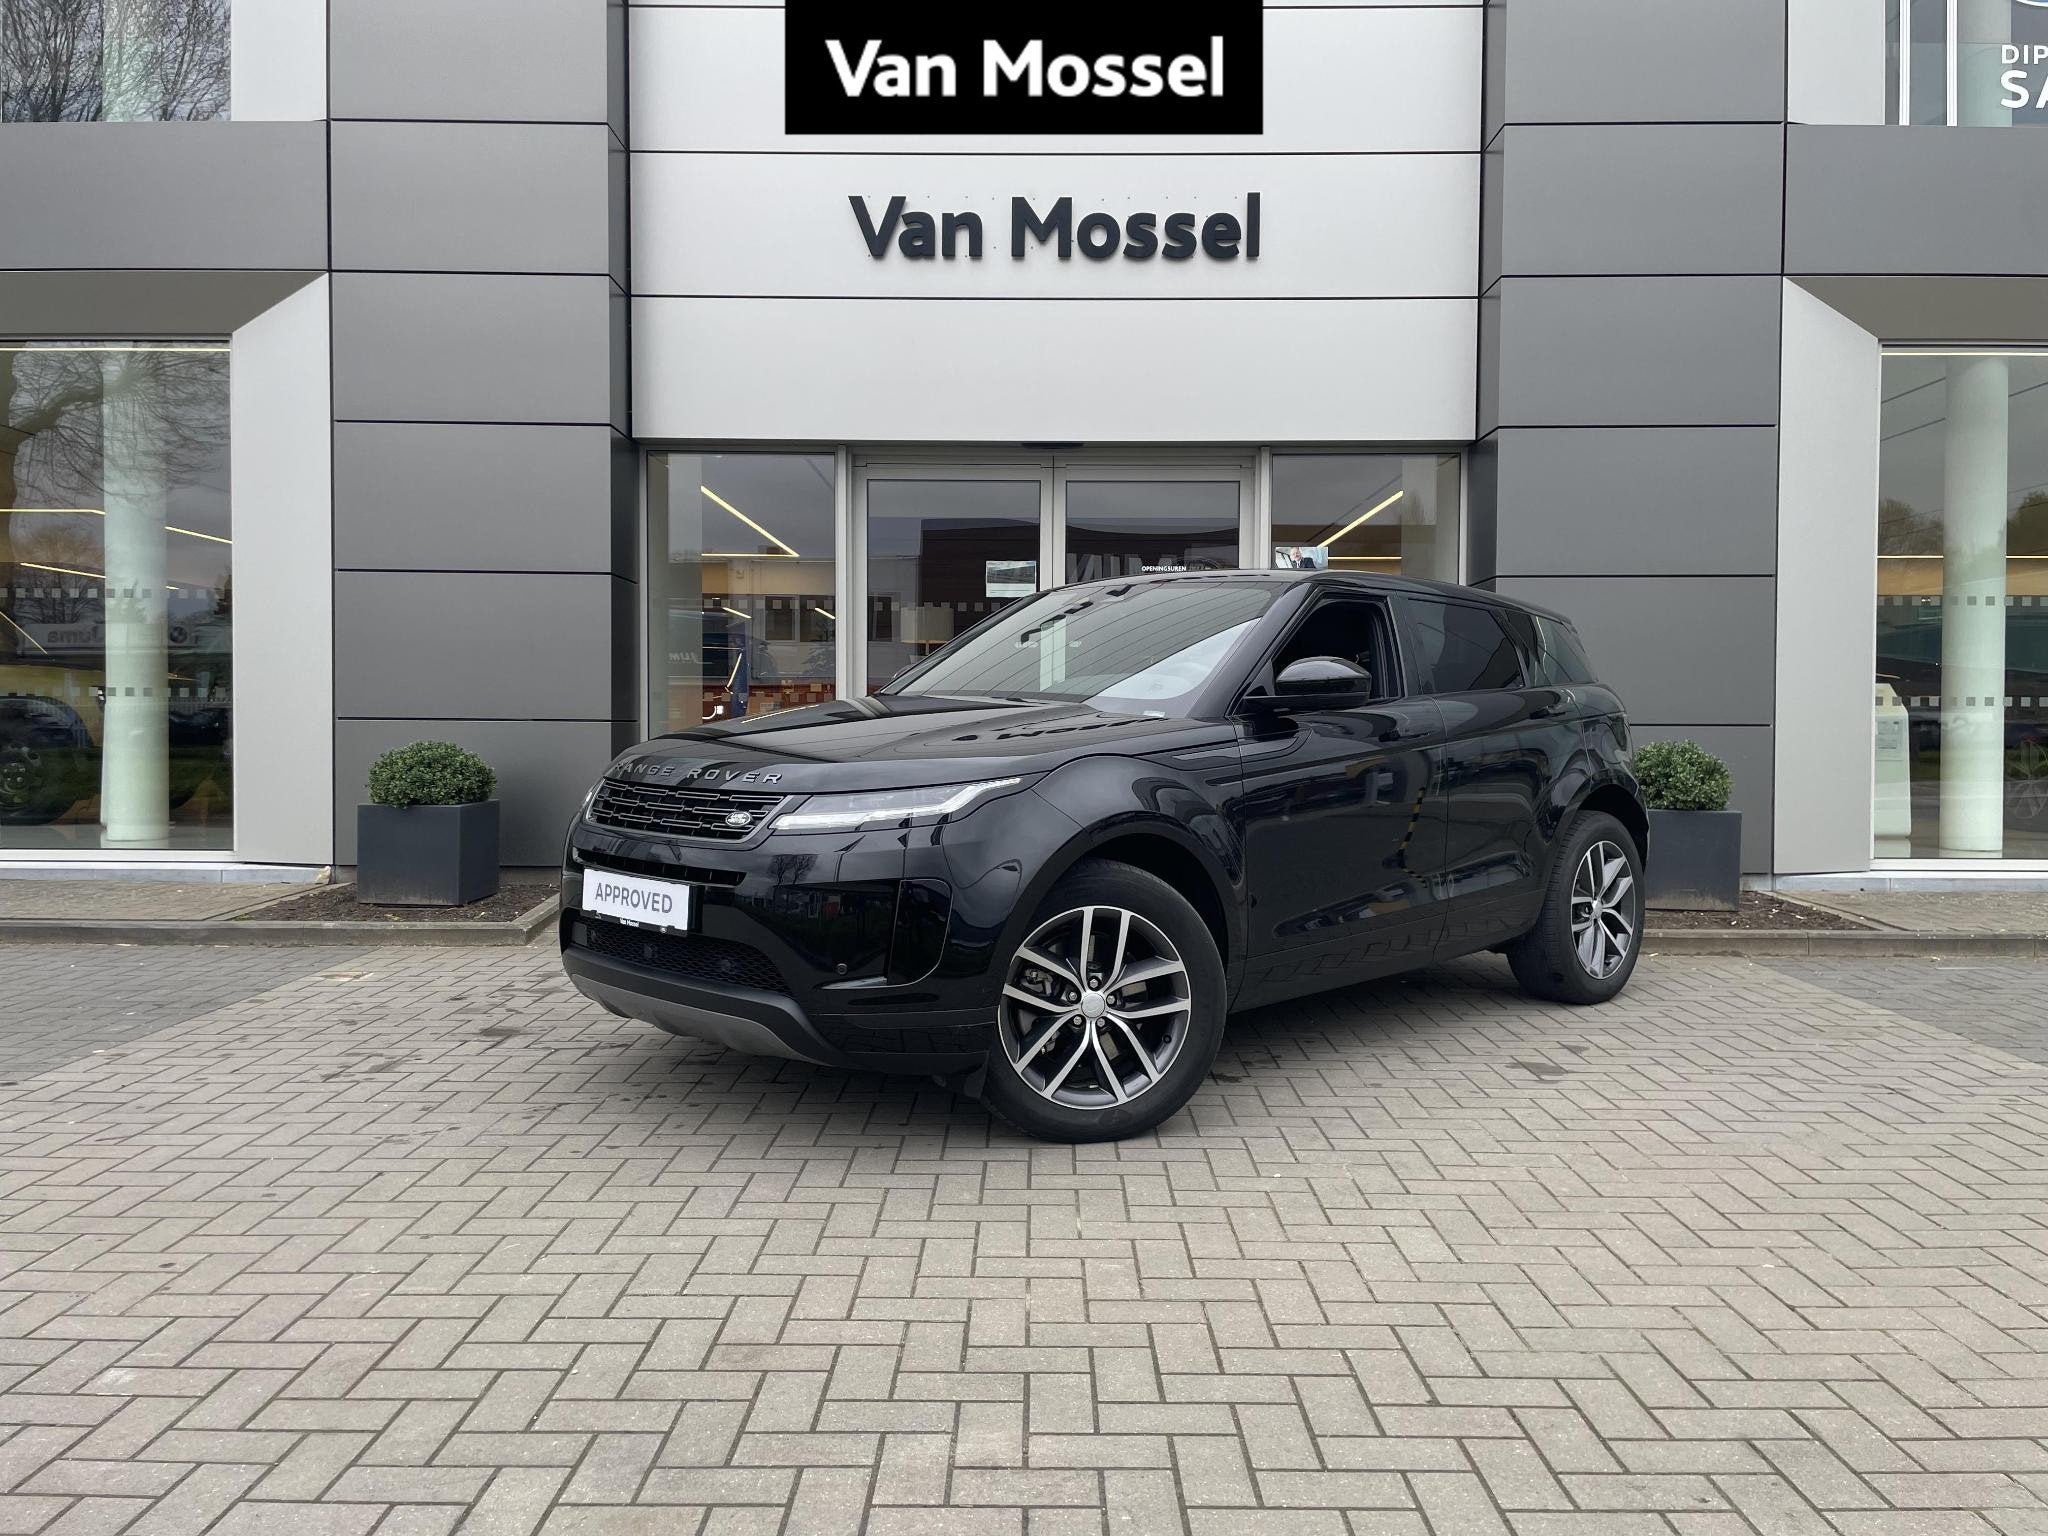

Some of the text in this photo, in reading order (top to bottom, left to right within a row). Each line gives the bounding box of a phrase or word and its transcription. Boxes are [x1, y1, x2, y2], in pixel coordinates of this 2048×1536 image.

[848, 192, 1261, 263] Van Mossel
[1141, 565, 1187, 573] OPENINGSUREN
[614, 762, 783, 784] RANGE ROVER
[594, 882, 673, 914] APPROVED
